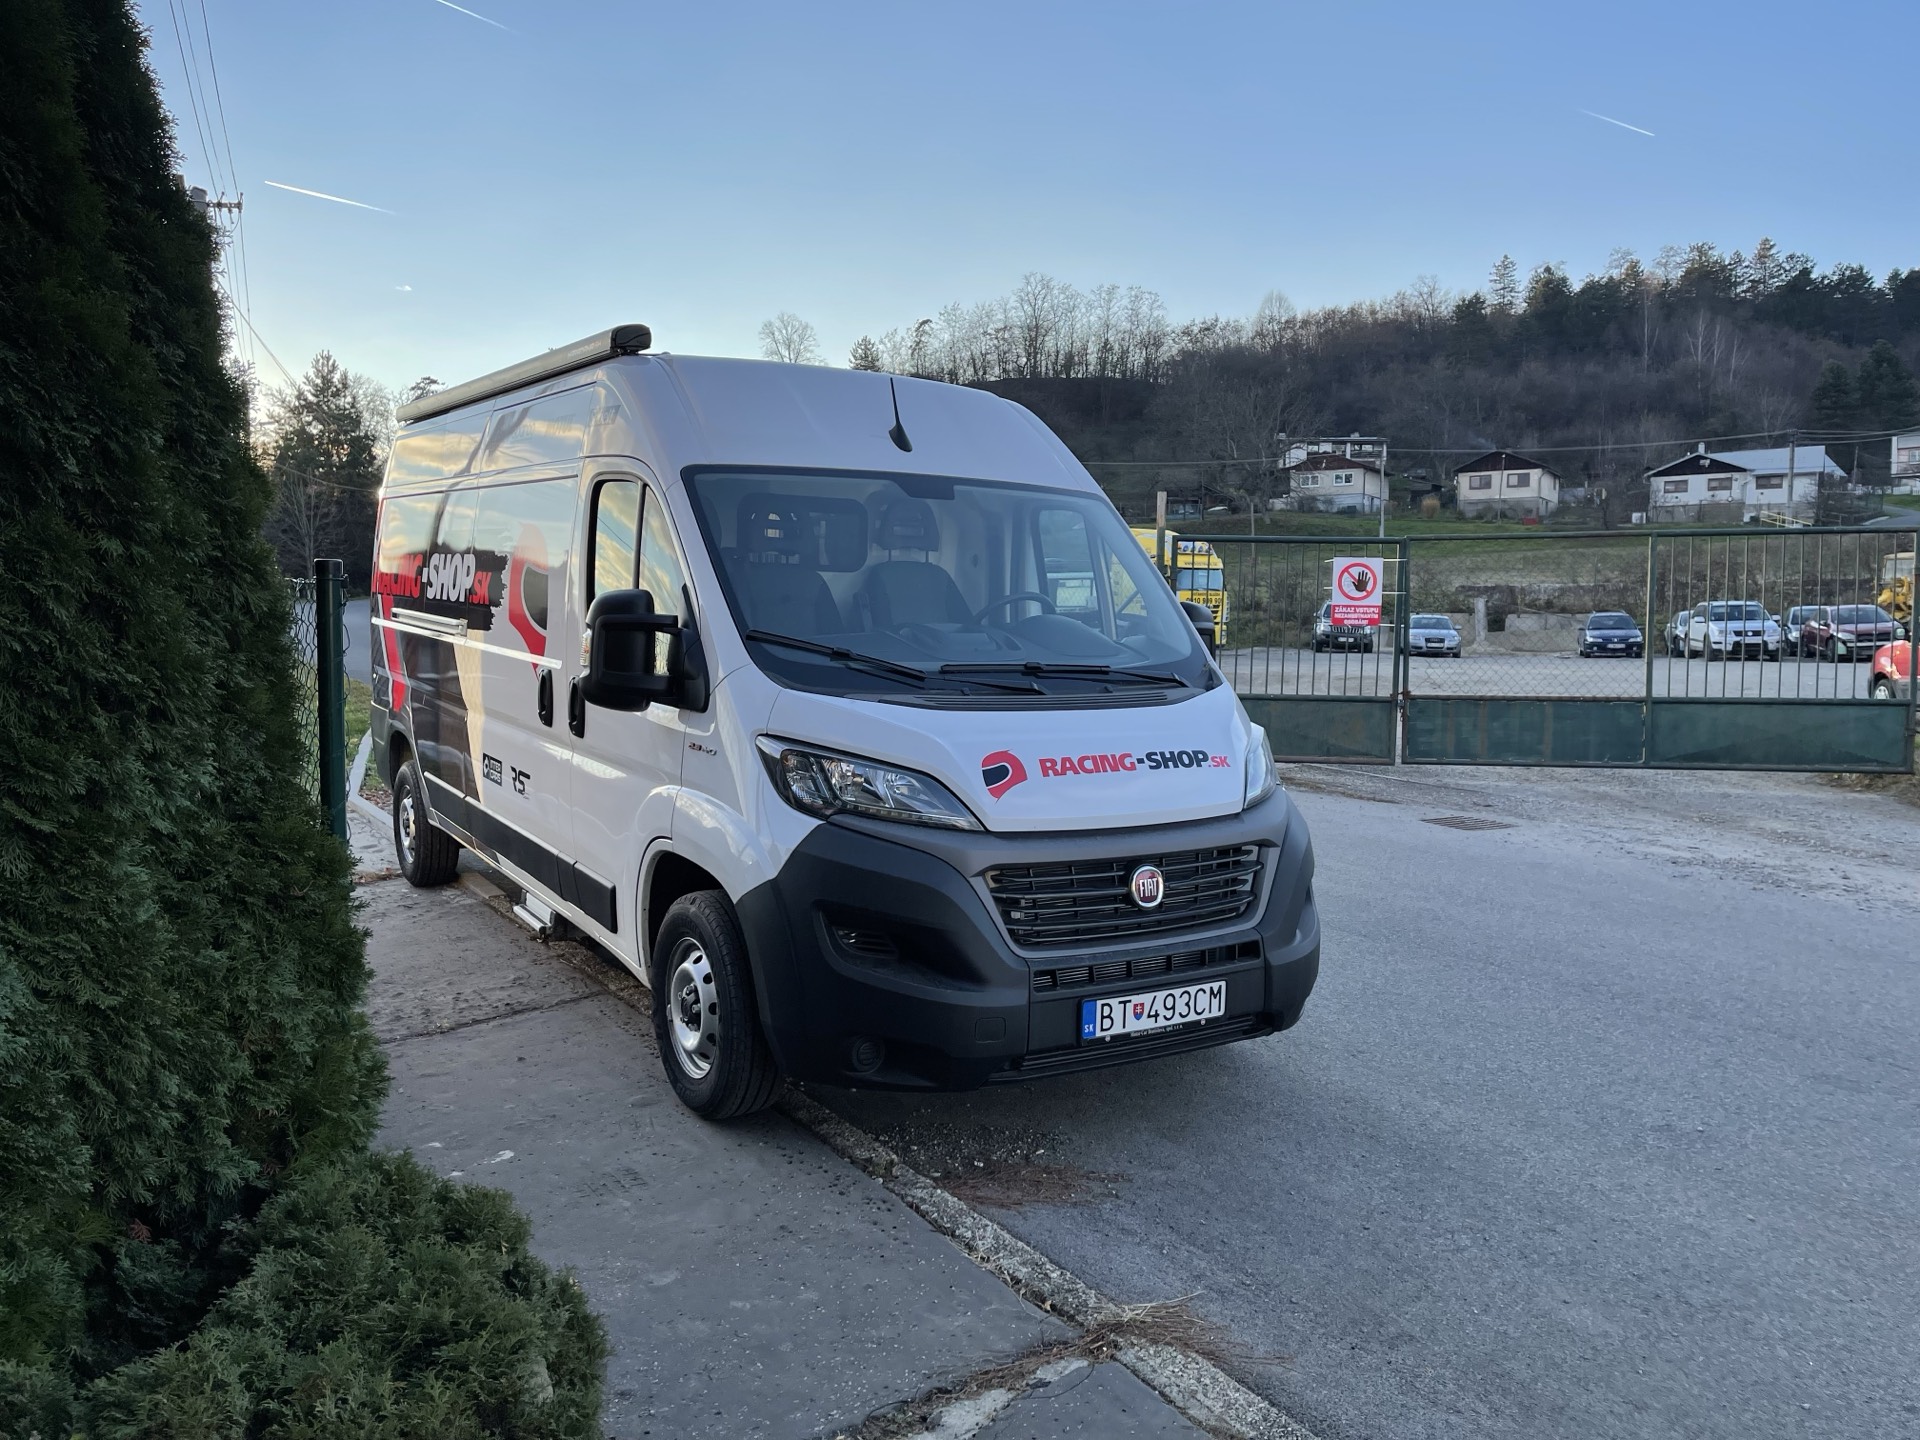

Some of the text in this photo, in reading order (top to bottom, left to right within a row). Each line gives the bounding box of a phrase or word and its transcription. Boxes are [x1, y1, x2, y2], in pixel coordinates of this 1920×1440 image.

[1334, 605, 1355, 613] ZÁKAZ
[1139, 877, 1158, 898] FIAT
[1100, 984, 1223, 1032] BT 493CM
[1084, 1023, 1094, 1033] SK
